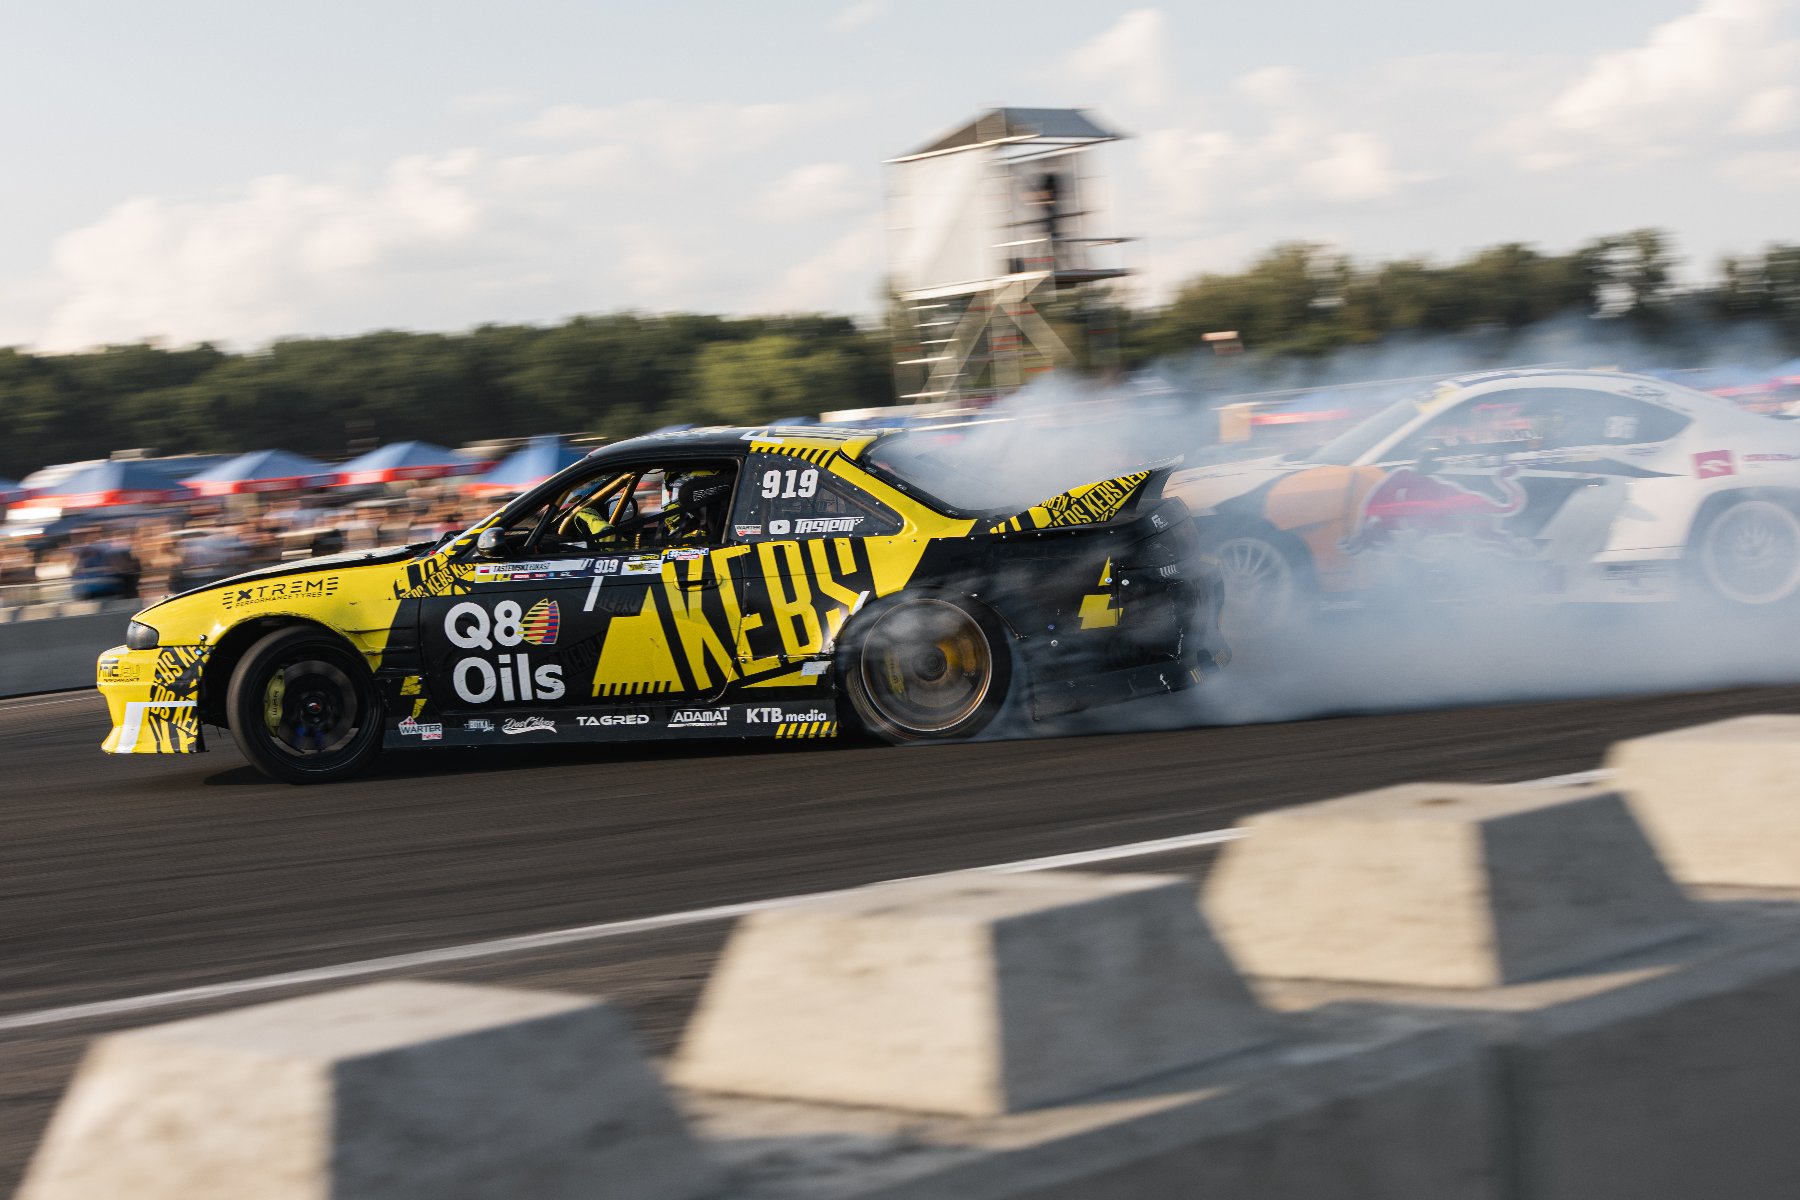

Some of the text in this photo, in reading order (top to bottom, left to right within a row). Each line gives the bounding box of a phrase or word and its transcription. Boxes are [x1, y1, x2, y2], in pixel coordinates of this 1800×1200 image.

[762, 469, 819, 498] 919
[1080, 480, 1124, 516] KEBS
[594, 559, 619, 574] 919
[222, 577, 339, 609] EXTREME
[295, 591, 322, 599] TYRES
[425, 567, 455, 595] KEBS
[444, 600, 525, 651] Q8
[453, 653, 566, 704] Oils
[401, 725, 441, 734] WARTER
[576, 715, 650, 726] TAGRED
[746, 707, 827, 724] KTB media
